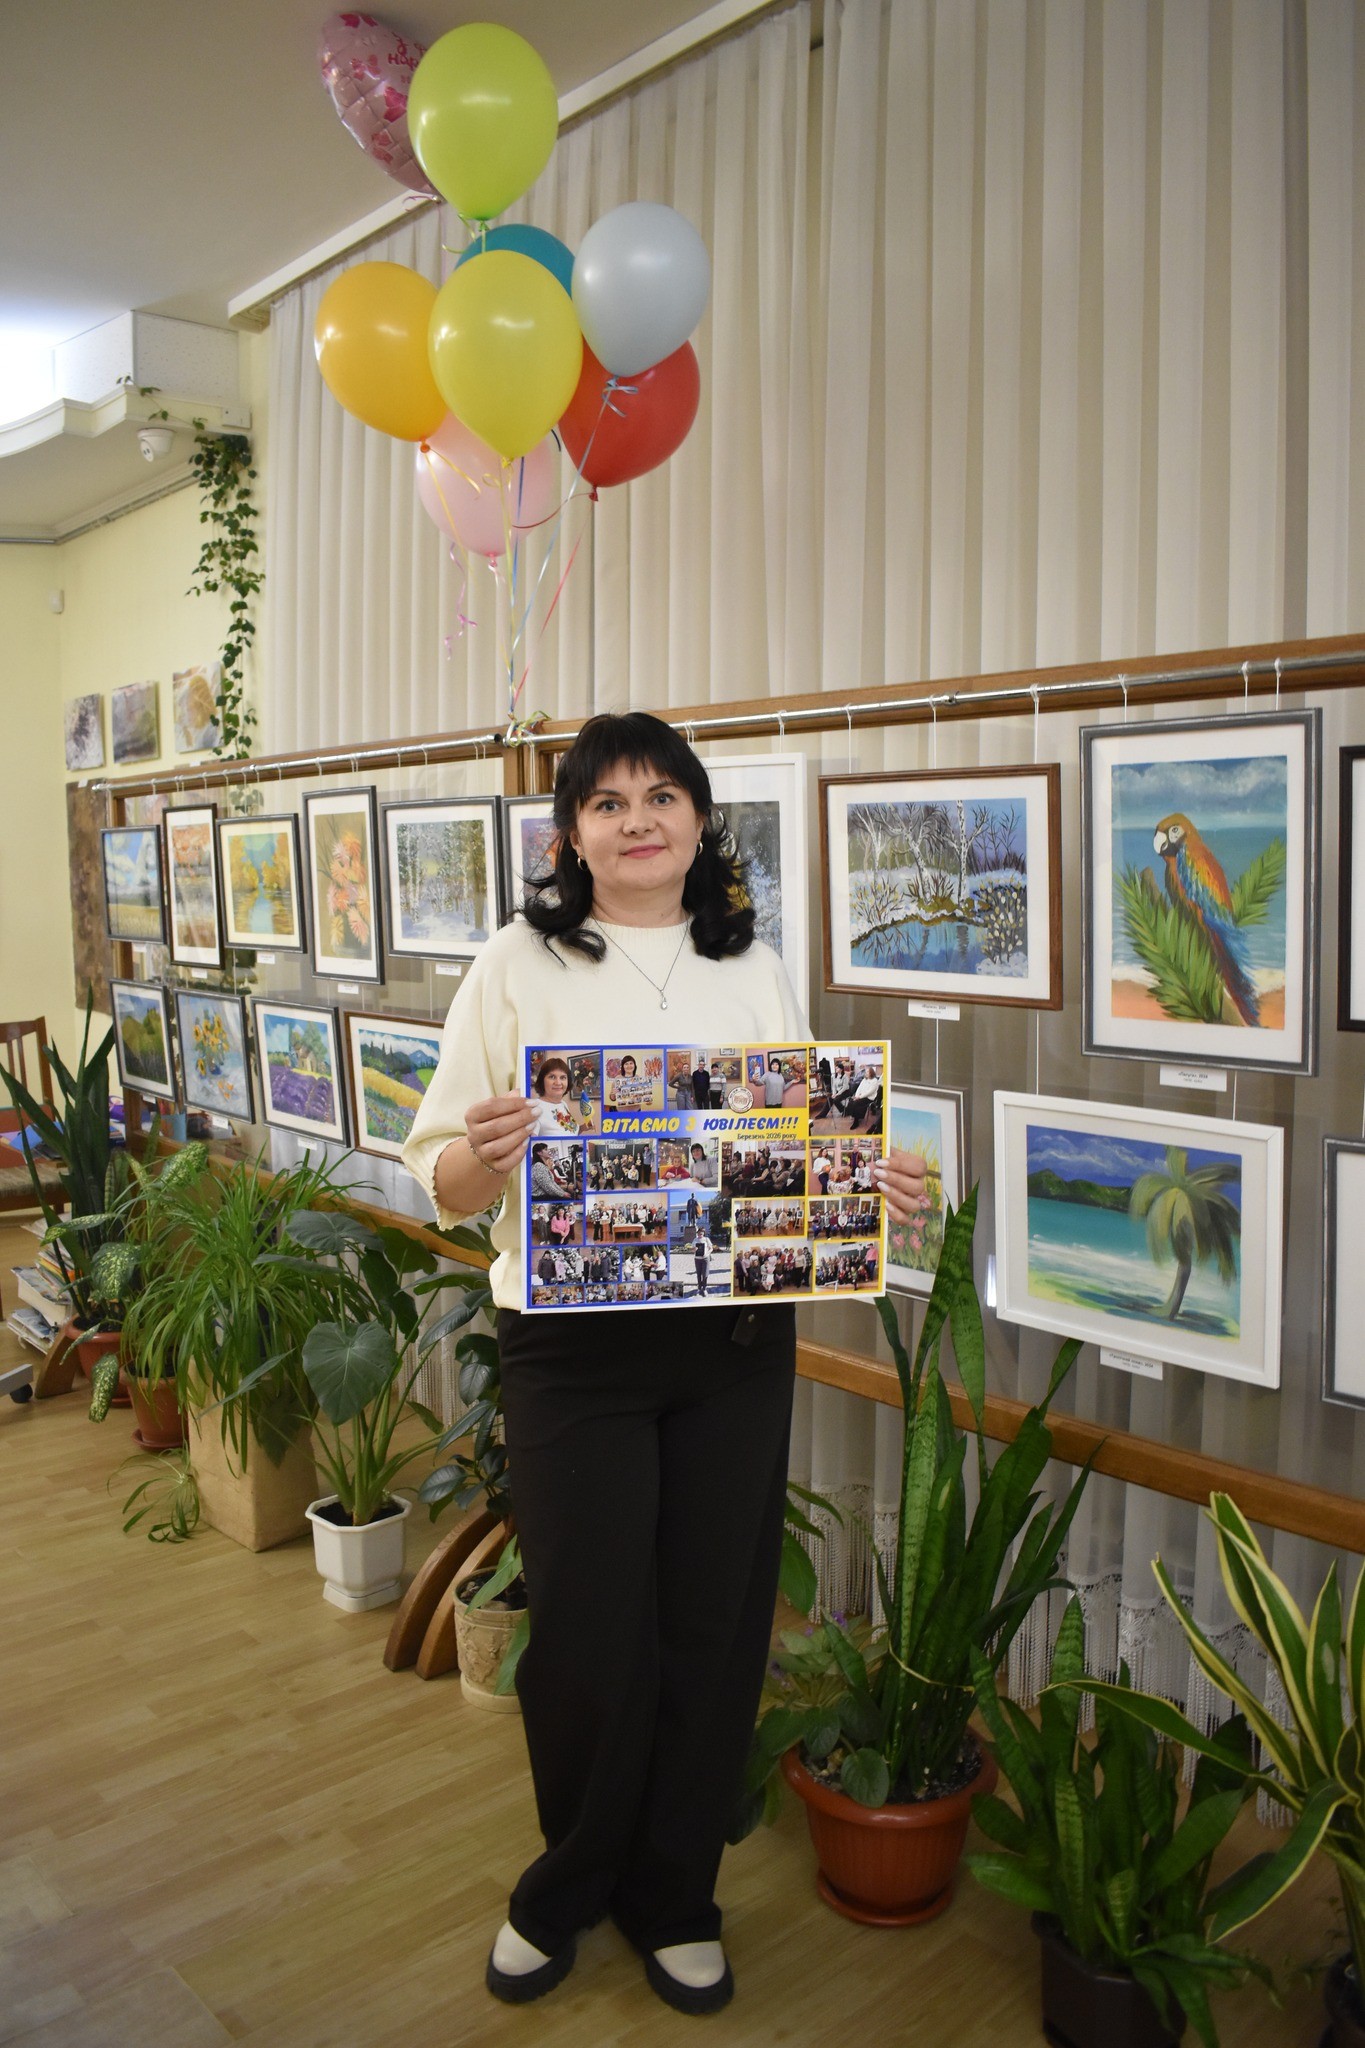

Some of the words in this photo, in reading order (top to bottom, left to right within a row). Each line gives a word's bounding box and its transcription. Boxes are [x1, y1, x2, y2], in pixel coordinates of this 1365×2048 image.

[602, 1117, 681, 1134] ВІТАЄМО
[685, 1117, 697, 1133] З
[702, 1116, 800, 1132] ЮВІЛЕЄМ!!!
[737, 1133, 765, 1141] Березень
